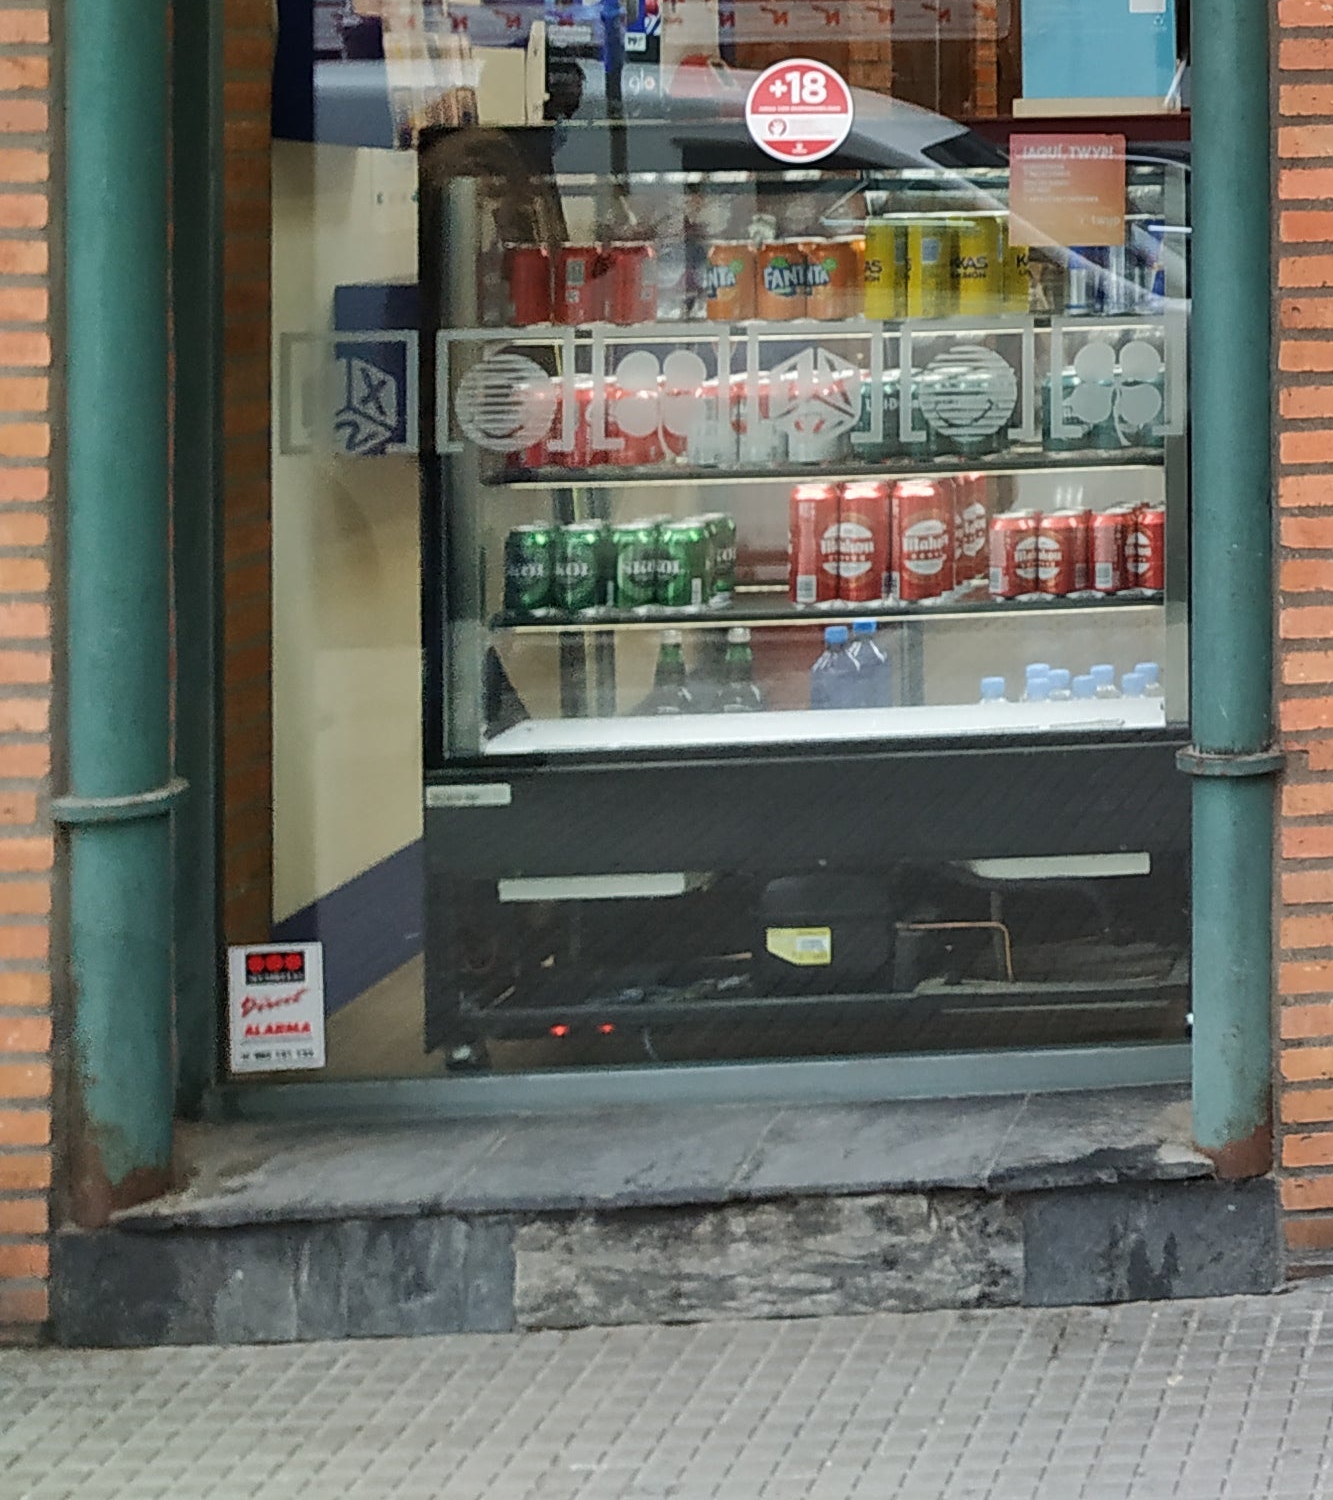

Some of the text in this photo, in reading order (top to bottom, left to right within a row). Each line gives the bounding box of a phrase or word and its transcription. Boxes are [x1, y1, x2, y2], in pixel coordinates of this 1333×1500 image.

[629, 67, 656, 94] glo
[769, 70, 828, 105] +18
[245, 1021, 312, 1038] ALARMA
